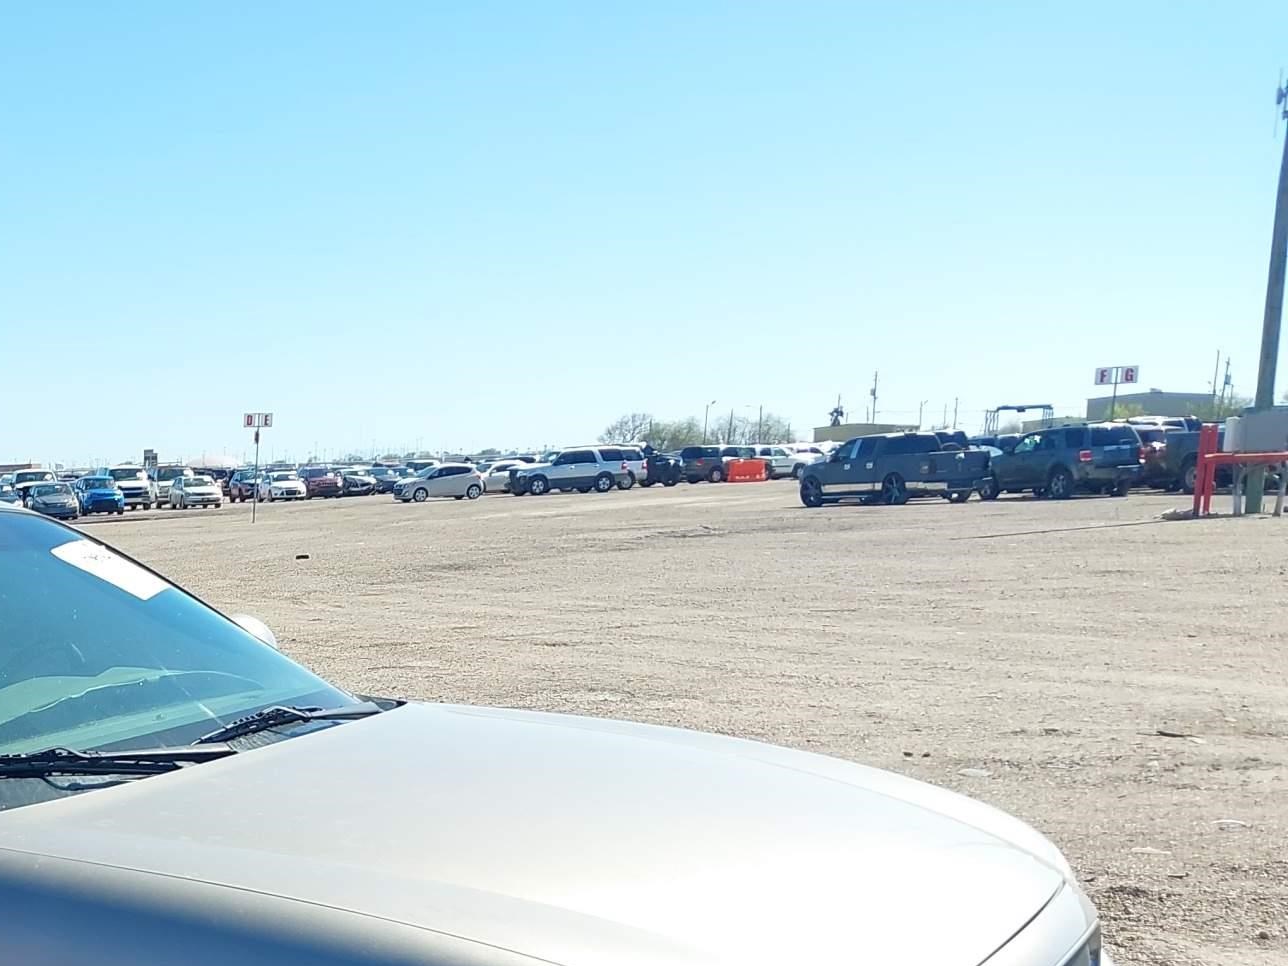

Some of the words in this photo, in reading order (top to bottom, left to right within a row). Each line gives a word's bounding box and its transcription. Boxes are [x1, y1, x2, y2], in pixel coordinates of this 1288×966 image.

[1099, 369, 1108, 383] F
[1124, 368, 1134, 382] G
[264, 415, 270, 426] E
